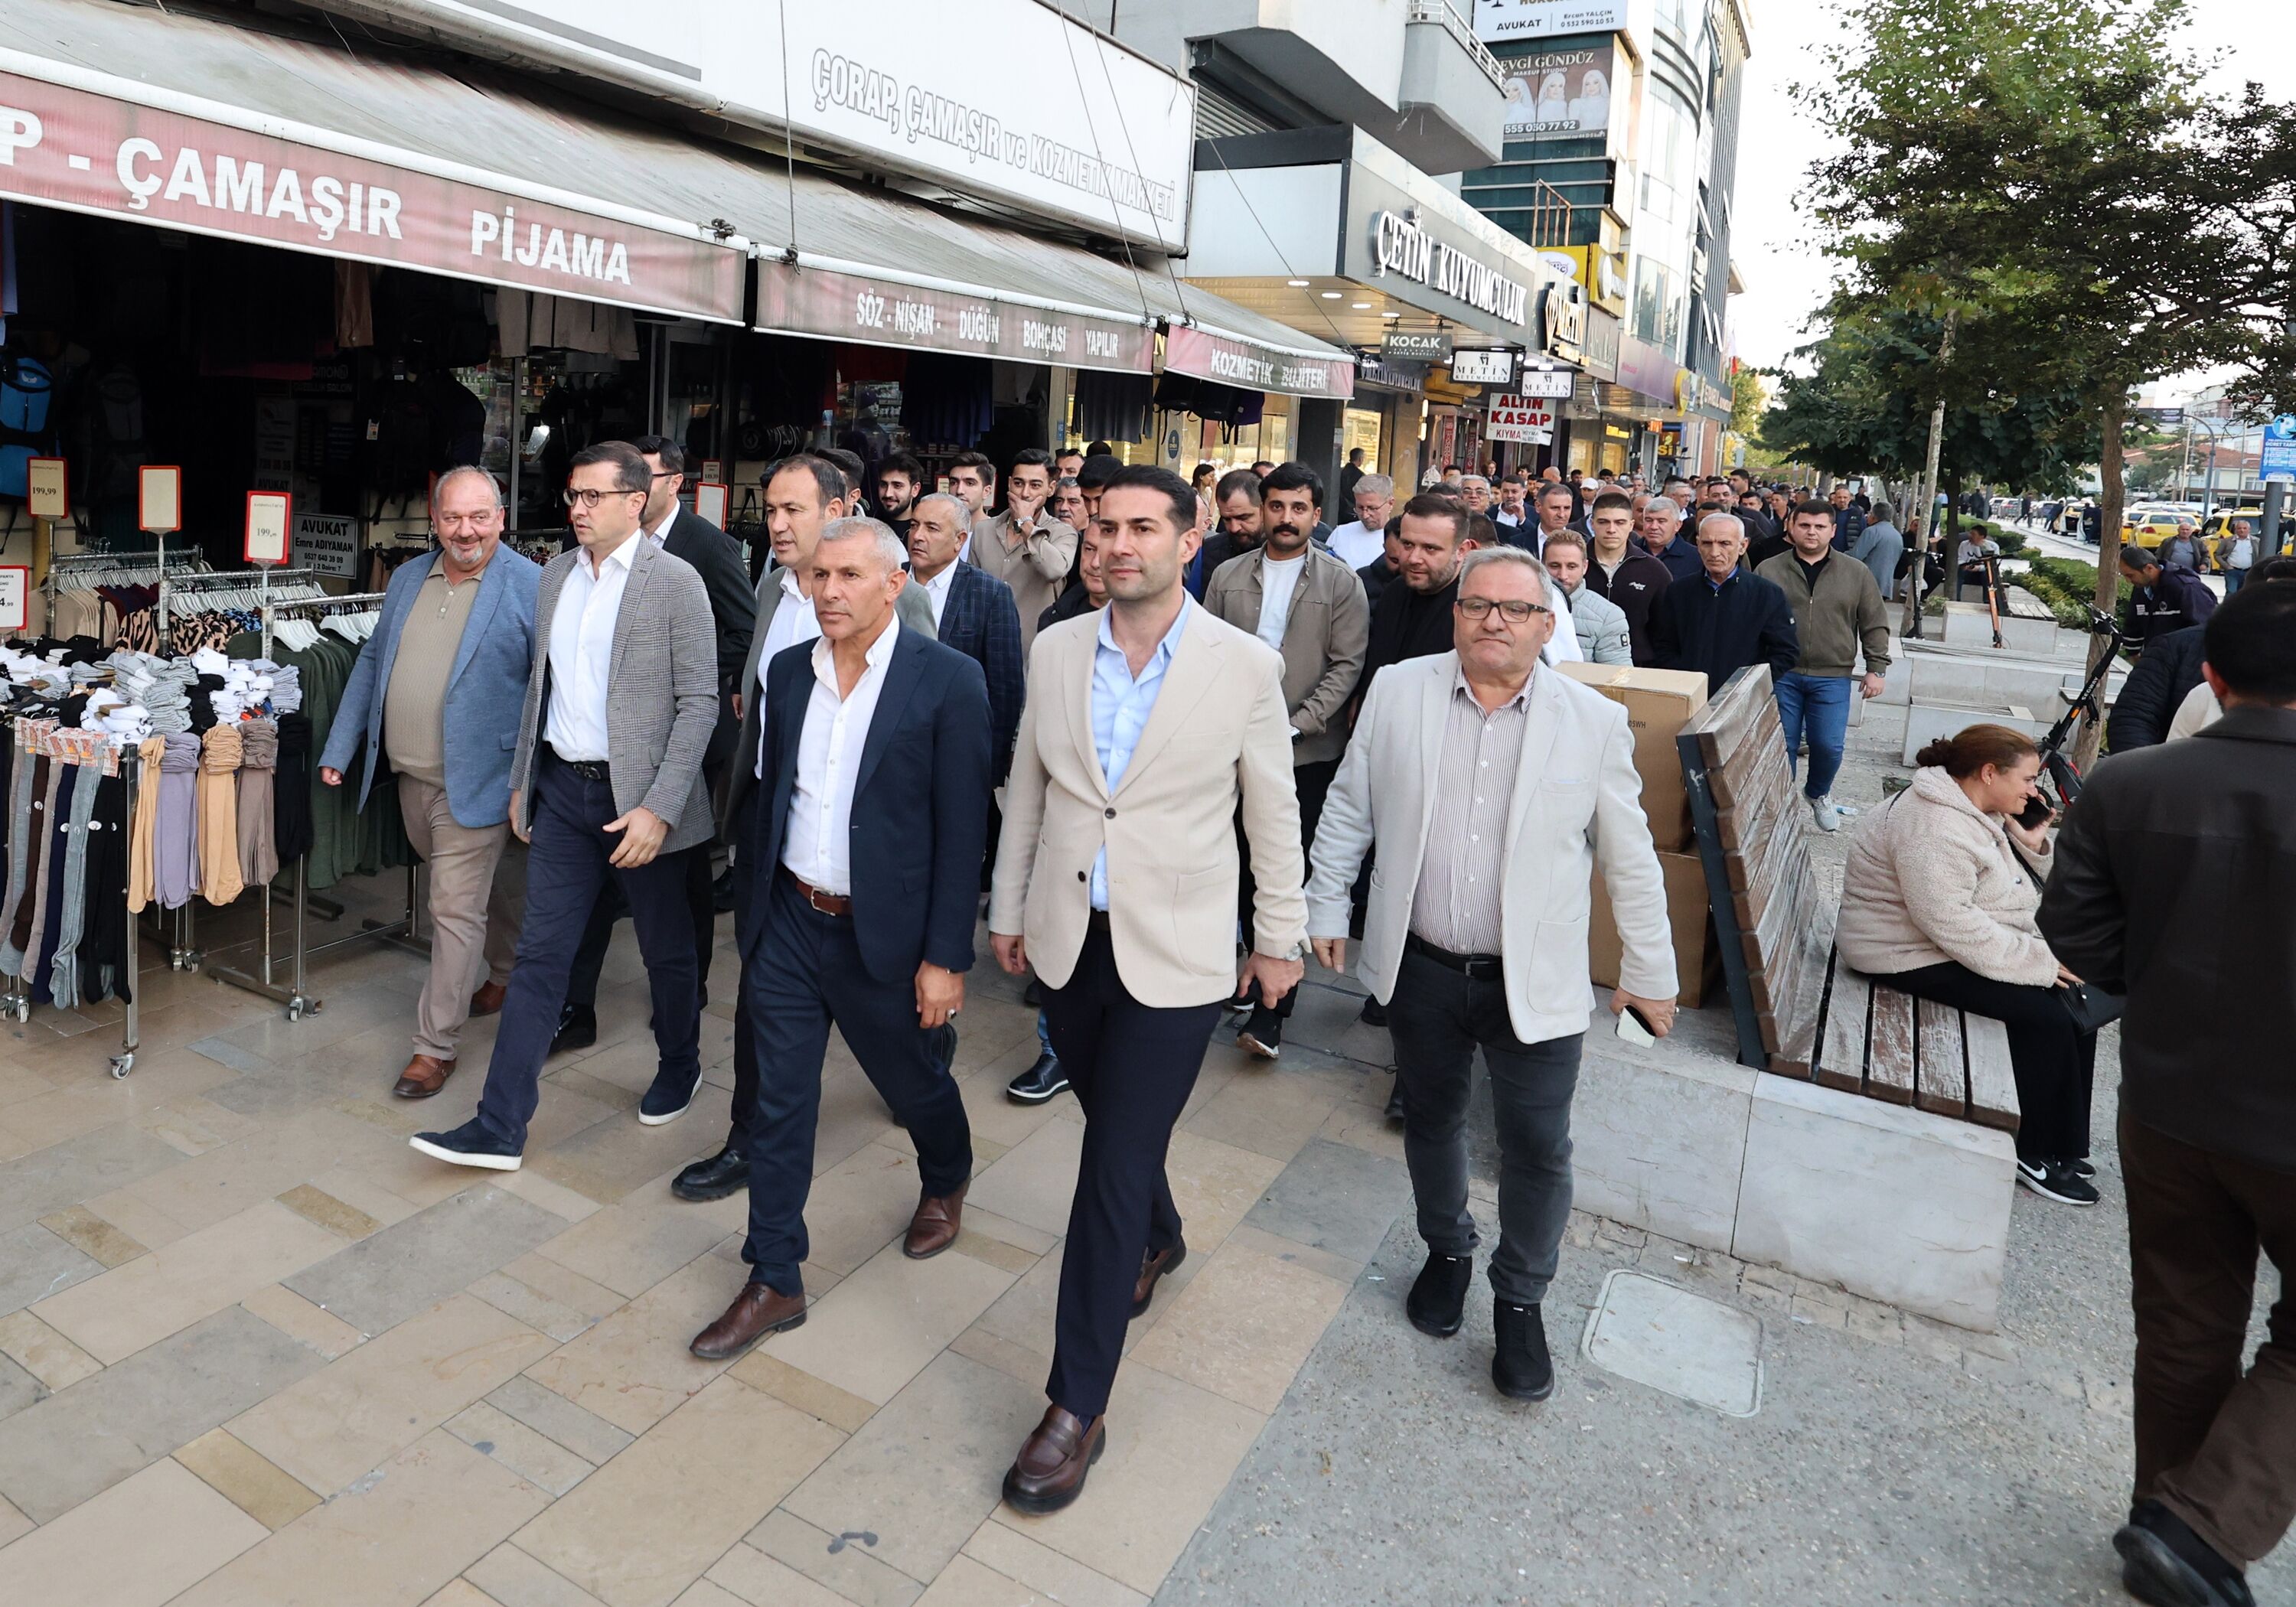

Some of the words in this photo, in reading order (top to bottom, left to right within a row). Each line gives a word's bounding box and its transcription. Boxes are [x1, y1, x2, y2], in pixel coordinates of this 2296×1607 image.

[1496, 19, 1542, 31] AVUKAT
[1499, 55, 1532, 71] EVGİ
[1534, 51, 1595, 68] GÜNDÜZ
[1548, 121, 1561, 131] 77
[1562, 120, 1576, 130] 92
[812, 47, 900, 135] ÇORAP,
[905, 85, 1001, 164] ÇAMAŞIR
[1004, 131, 1027, 170] ve
[1030, 133, 1113, 200] KOZMETİK
[1114, 166, 1176, 222] MARKETİ
[116, 136, 403, 241] ÇAMAŞIR
[471, 206, 631, 285] PİJAMA
[1378, 205, 1433, 285] ÇETİN
[1437, 241, 1528, 326] KUYUMCULUK
[959, 305, 1000, 344] DÜĞÜN
[1022, 319, 1067, 357] BOHÇASI
[1085, 329, 1119, 358] YAPILIR
[1211, 349, 1274, 385] KOZMETİK
[1456, 365, 1508, 376] METİN
[1524, 383, 1569, 391] METİN
[1490, 410, 1552, 426] KASAP
[1495, 429, 1521, 439] KIYMA
[301, 519, 349, 536] AVUKAT
[295, 536, 313, 548] Emre
[315, 539, 354, 553] ADIYAMAN
